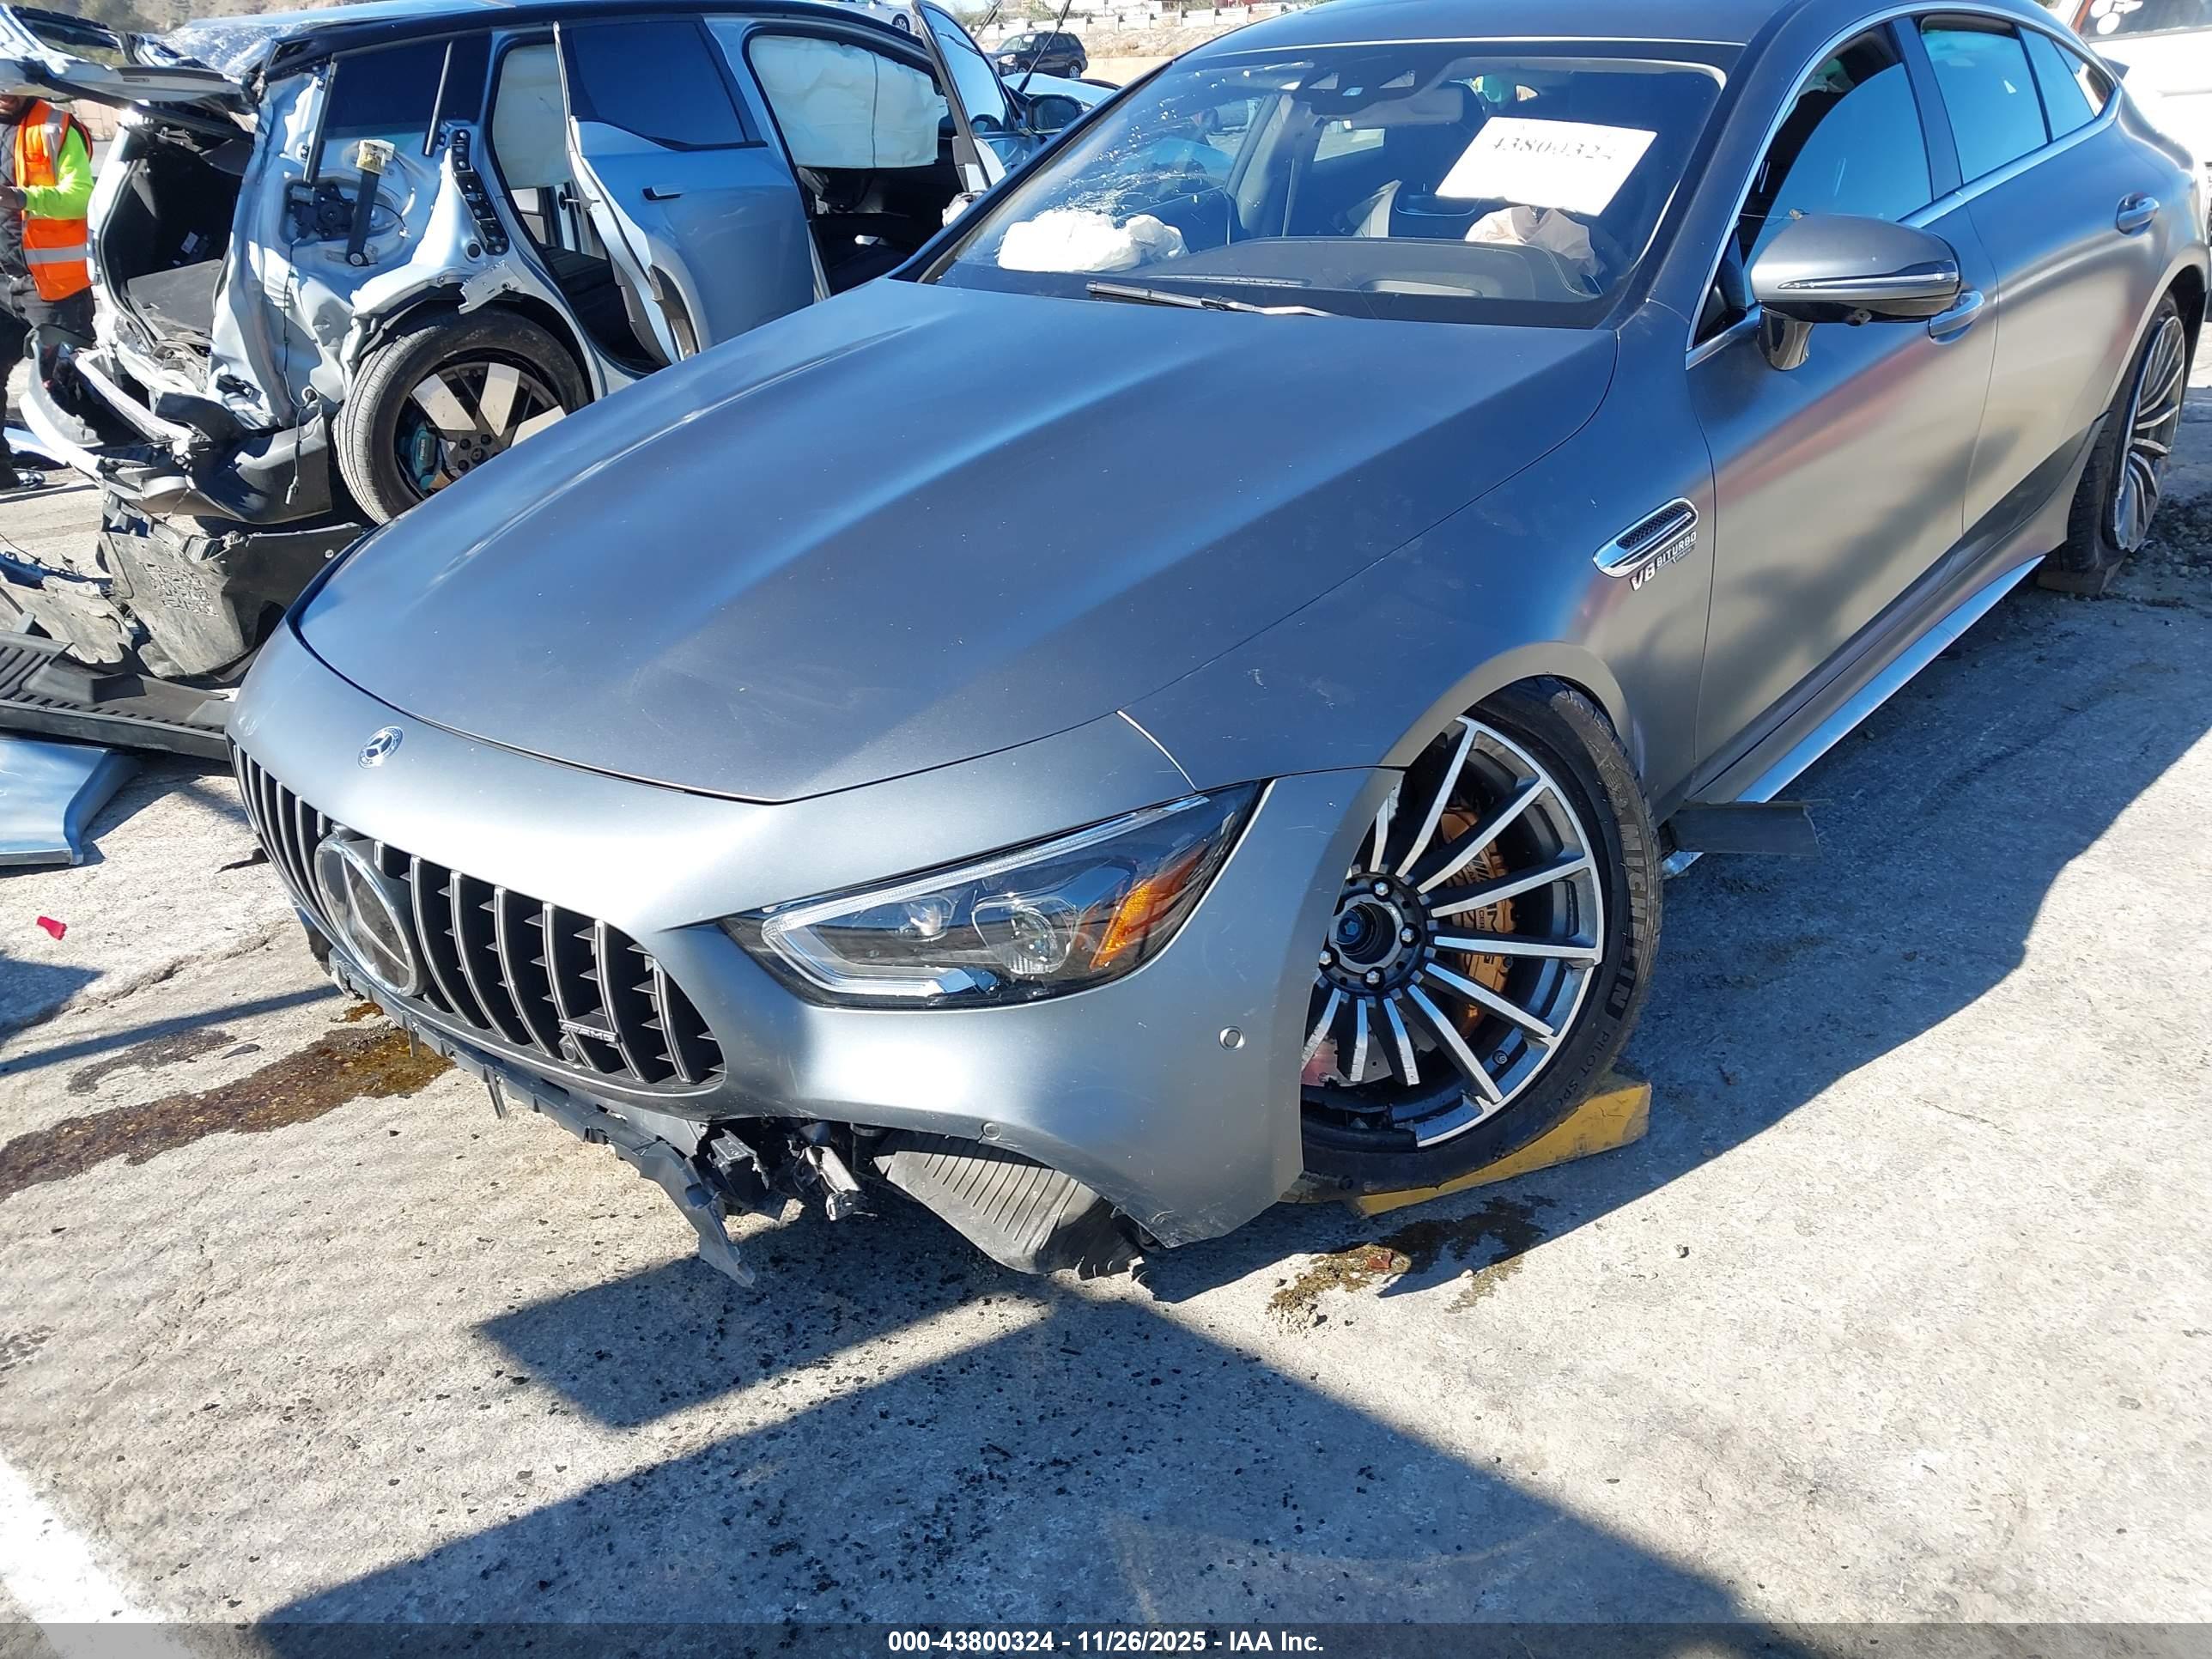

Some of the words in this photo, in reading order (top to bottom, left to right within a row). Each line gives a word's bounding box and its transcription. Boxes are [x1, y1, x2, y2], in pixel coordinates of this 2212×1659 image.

[1656, 531, 1697, 568] BITURBO
[1611, 824, 1648, 1009] MICHELIN
[1581, 1030, 1610, 1077] PILOT
